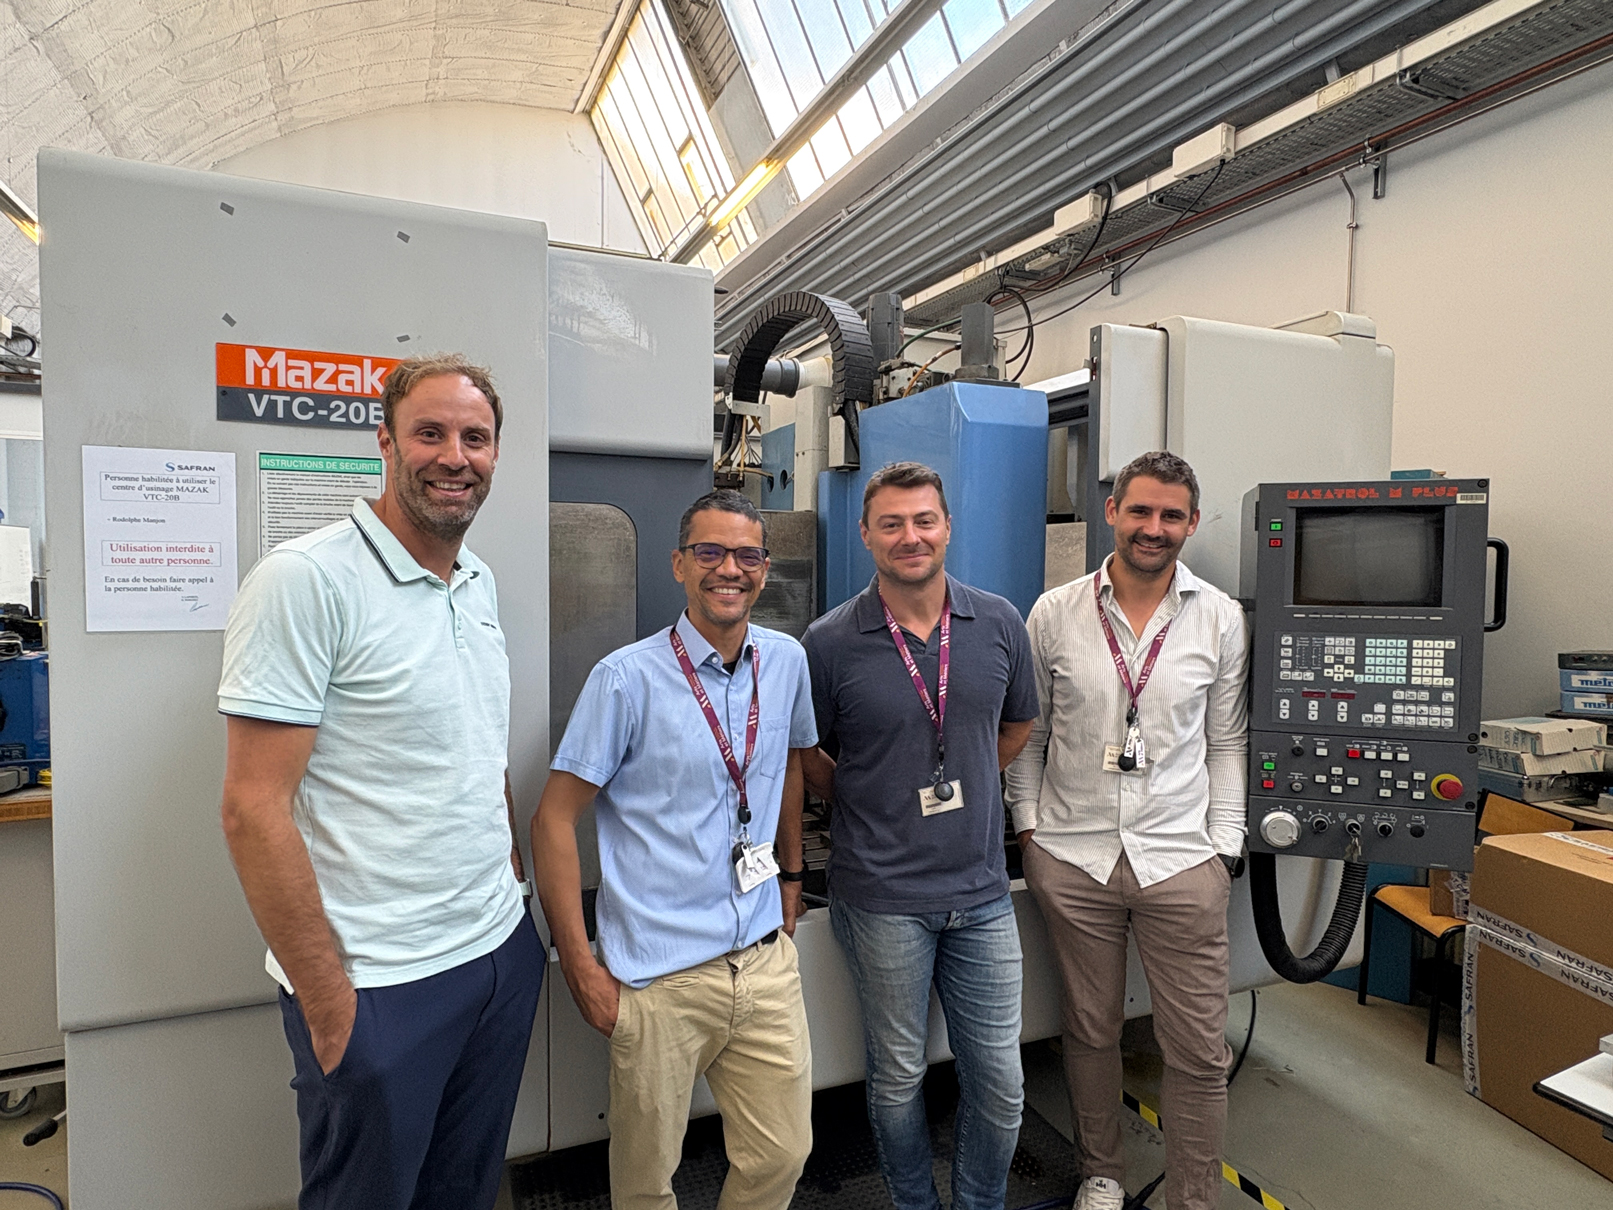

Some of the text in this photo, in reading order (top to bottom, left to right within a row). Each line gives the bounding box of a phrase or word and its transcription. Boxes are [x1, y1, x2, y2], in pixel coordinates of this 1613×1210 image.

[245, 348, 388, 395] Mazak
[247, 393, 385, 425] VTC-20B
[177, 464, 216, 472] SAFRAN
[261, 458, 380, 471] INSTRUCTIONS DE SECURITE
[104, 474, 140, 482] Personne
[141, 475, 174, 484] habilitée
[182, 477, 207, 485] utiliser
[143, 493, 180, 501] VTC-20B
[1286, 486, 1459, 500] MAZATROL M PLUS
[112, 516, 141, 524] Rodolphe
[110, 543, 214, 553] Utilisation interdite à
[111, 556, 214, 567] toute autre personne.
[187, 577, 208, 585] appel
[1477, 911, 1523, 939] SAFRAN
[1480, 929, 1526, 958] SAFRAN
[1556, 950, 1613, 981] SAFRAN
[1465, 952, 1474, 1002] SAFRAN
[1466, 1033, 1476, 1083] SAFRAN
